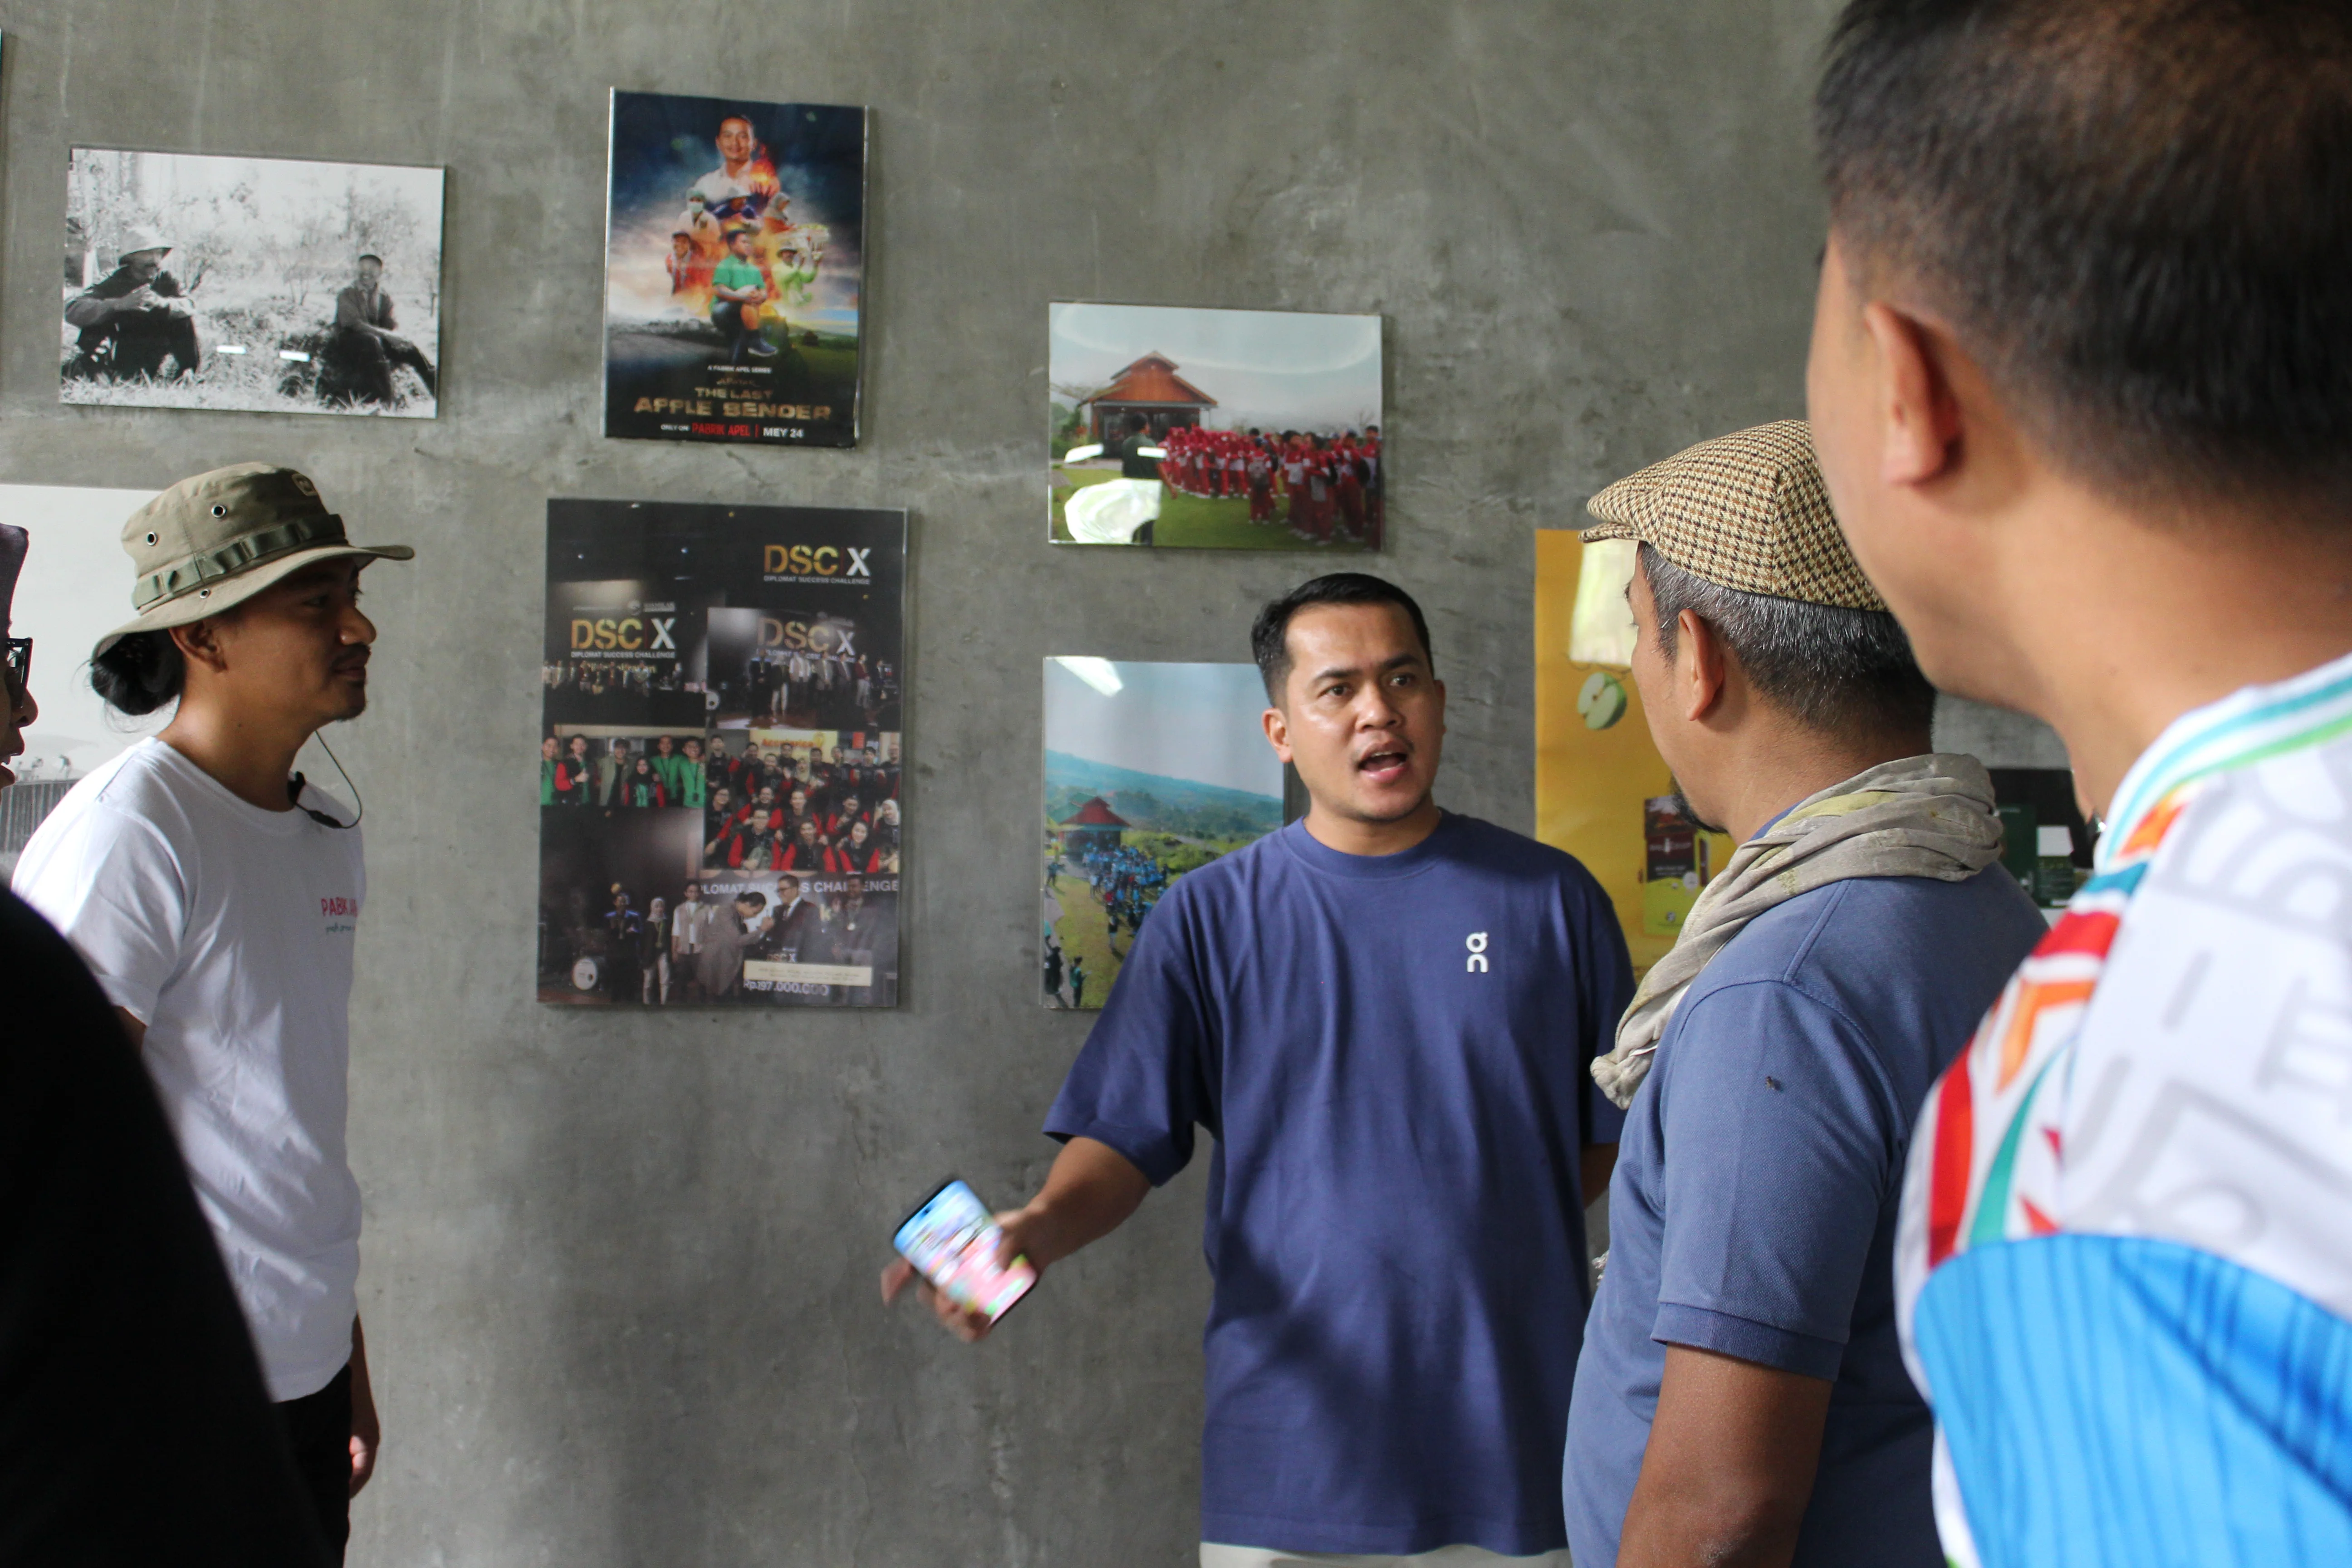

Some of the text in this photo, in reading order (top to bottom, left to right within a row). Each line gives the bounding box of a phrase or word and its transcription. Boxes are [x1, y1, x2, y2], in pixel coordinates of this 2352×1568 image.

[694, 387, 774, 400] THE LAST
[634, 397, 712, 416] APPLE
[692, 422, 725, 435] PABRIK
[728, 424, 750, 436] APEL
[763, 427, 788, 437] MEY
[789, 428, 804, 438] 24
[764, 544, 871, 577] DSC X
[798, 576, 830, 584] SUCCESS
[830, 577, 870, 585] CHALLENGE
[571, 617, 676, 650] DSC X
[757, 617, 856, 656] DSC X
